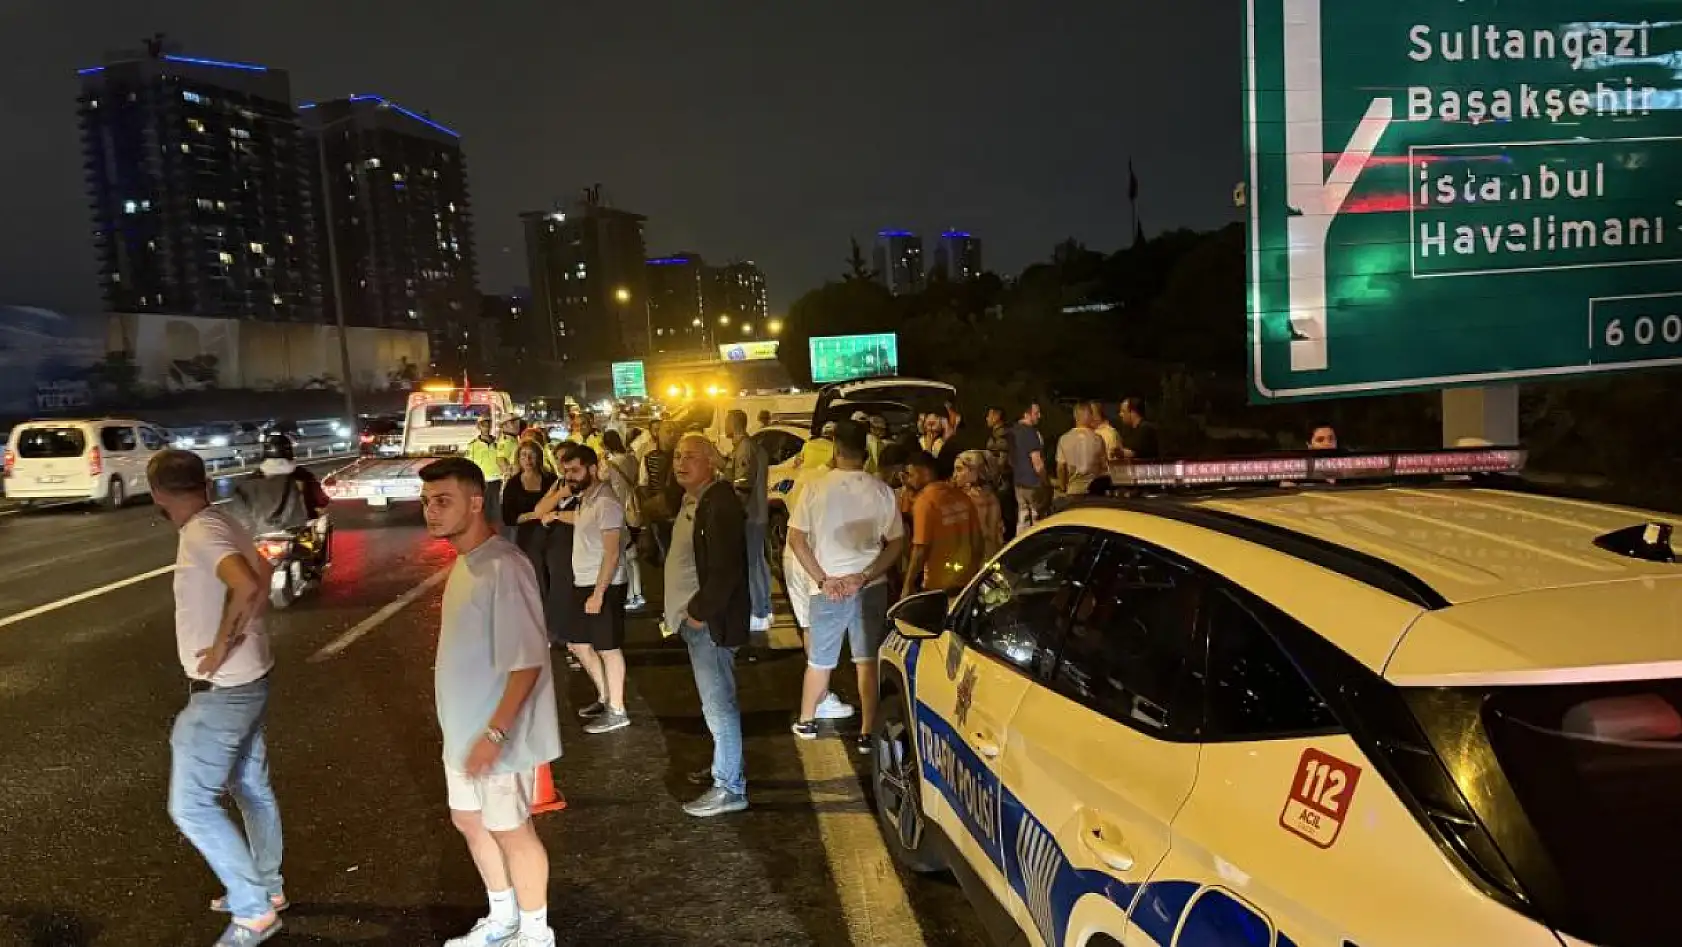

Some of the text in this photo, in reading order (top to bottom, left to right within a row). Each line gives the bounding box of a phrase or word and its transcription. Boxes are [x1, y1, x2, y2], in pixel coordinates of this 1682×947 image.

[1408, 20, 1649, 69] Sultangazi
[1407, 76, 1657, 125] Başakşehir
[1420, 214, 1664, 258] Havelimanı
[1605, 314, 1682, 346] 600
[1300, 760, 1347, 813] 112
